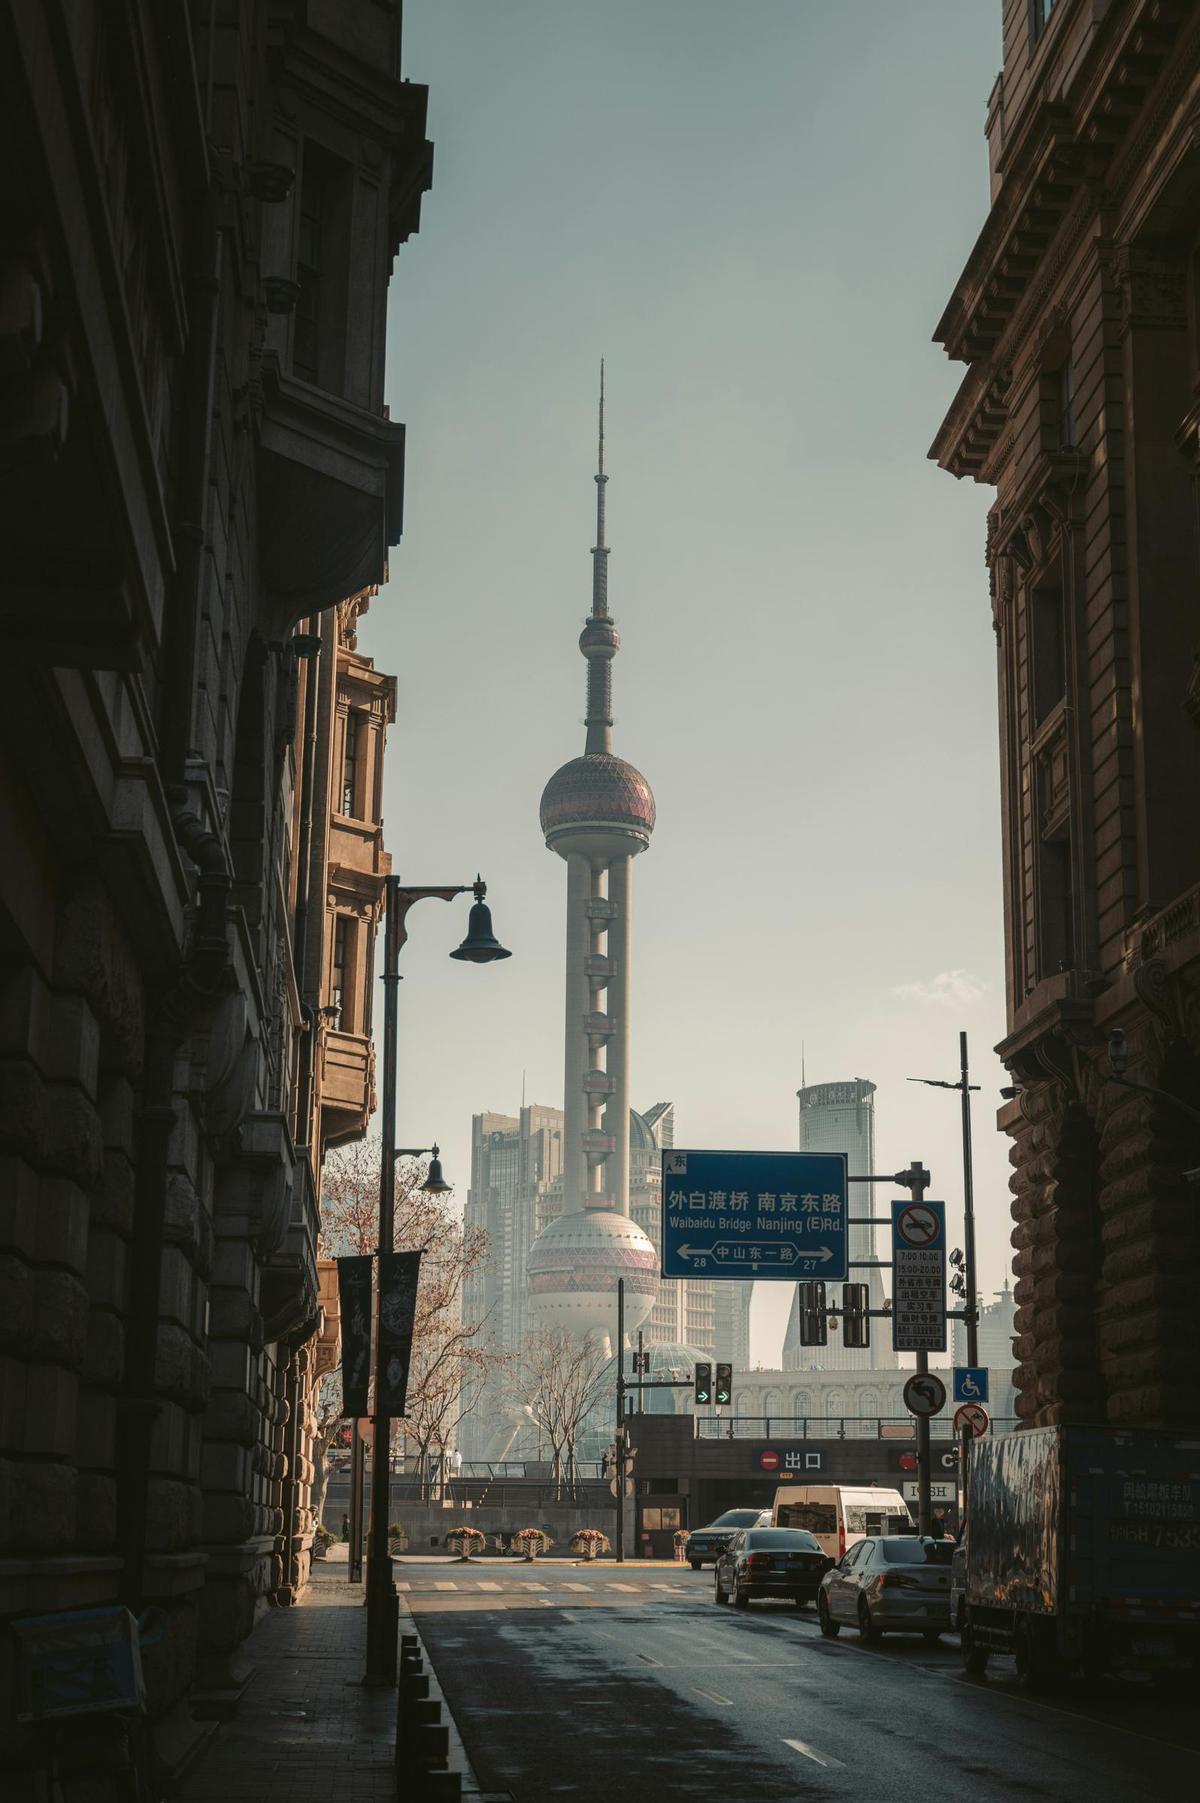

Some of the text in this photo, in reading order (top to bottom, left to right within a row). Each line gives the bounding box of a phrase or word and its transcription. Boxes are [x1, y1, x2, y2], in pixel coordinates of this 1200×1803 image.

[674, 1155, 687, 1167] 东
[668, 1190, 842, 1213] 外白渡桥 南京东路
[669, 1216, 716, 1229] Waibaidu
[719, 1217, 752, 1232] Bridge
[757, 1217, 803, 1233] Nanjing
[717, 1245, 794, 1261] 中山东一路
[693, 1257, 707, 1268] 28
[803, 1260, 817, 1270] 27
[785, 1452, 821, 1469] 出口
